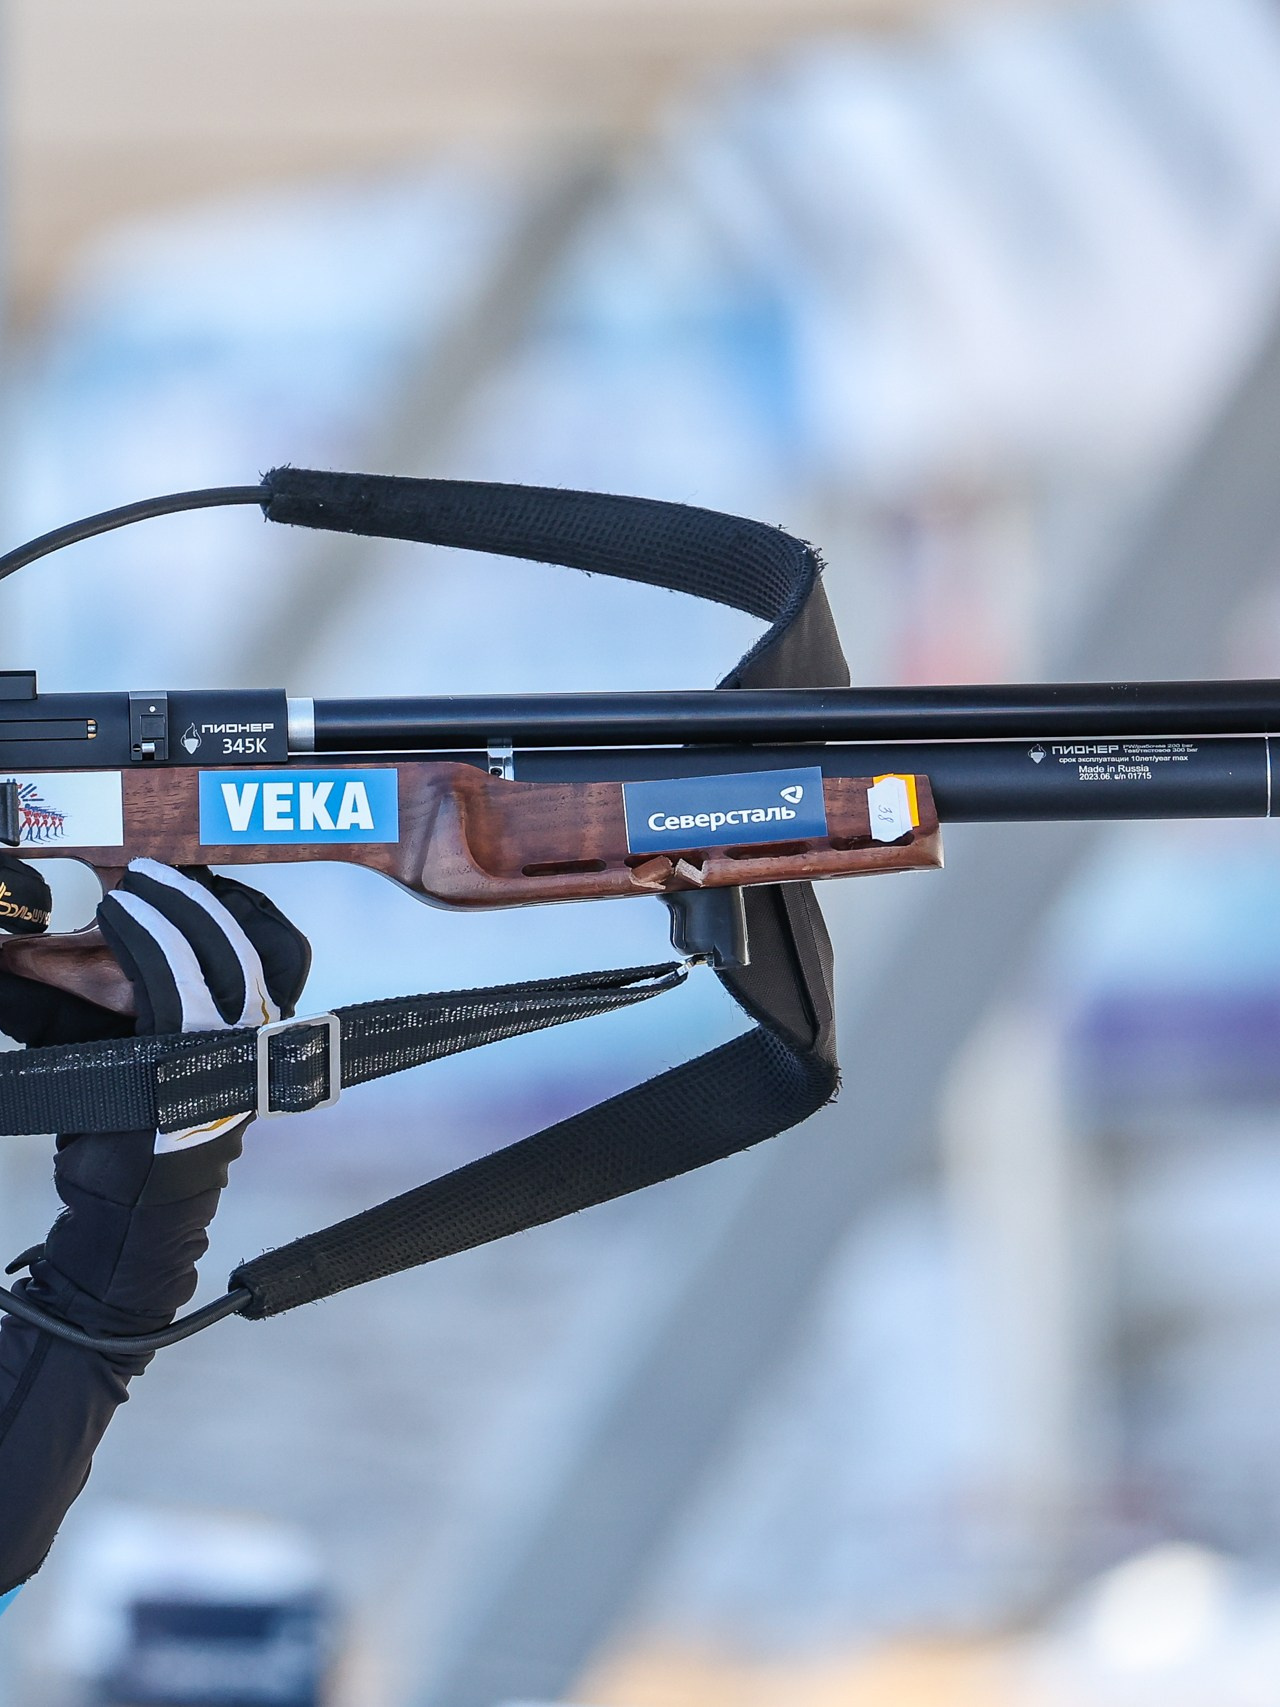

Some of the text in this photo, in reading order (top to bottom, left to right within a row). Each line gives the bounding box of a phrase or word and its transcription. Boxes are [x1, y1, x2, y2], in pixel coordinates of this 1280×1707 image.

[201, 723, 274, 734] ПИОНЕР
[1051, 744, 1119, 755] ПИОНЕР
[1077, 756, 1129, 764] эксплуатации
[1078, 764, 1150, 773] Made in Russia
[1127, 772, 1152, 780] 01715
[221, 781, 375, 831] VEKA
[647, 806, 796, 832] Северсталь
